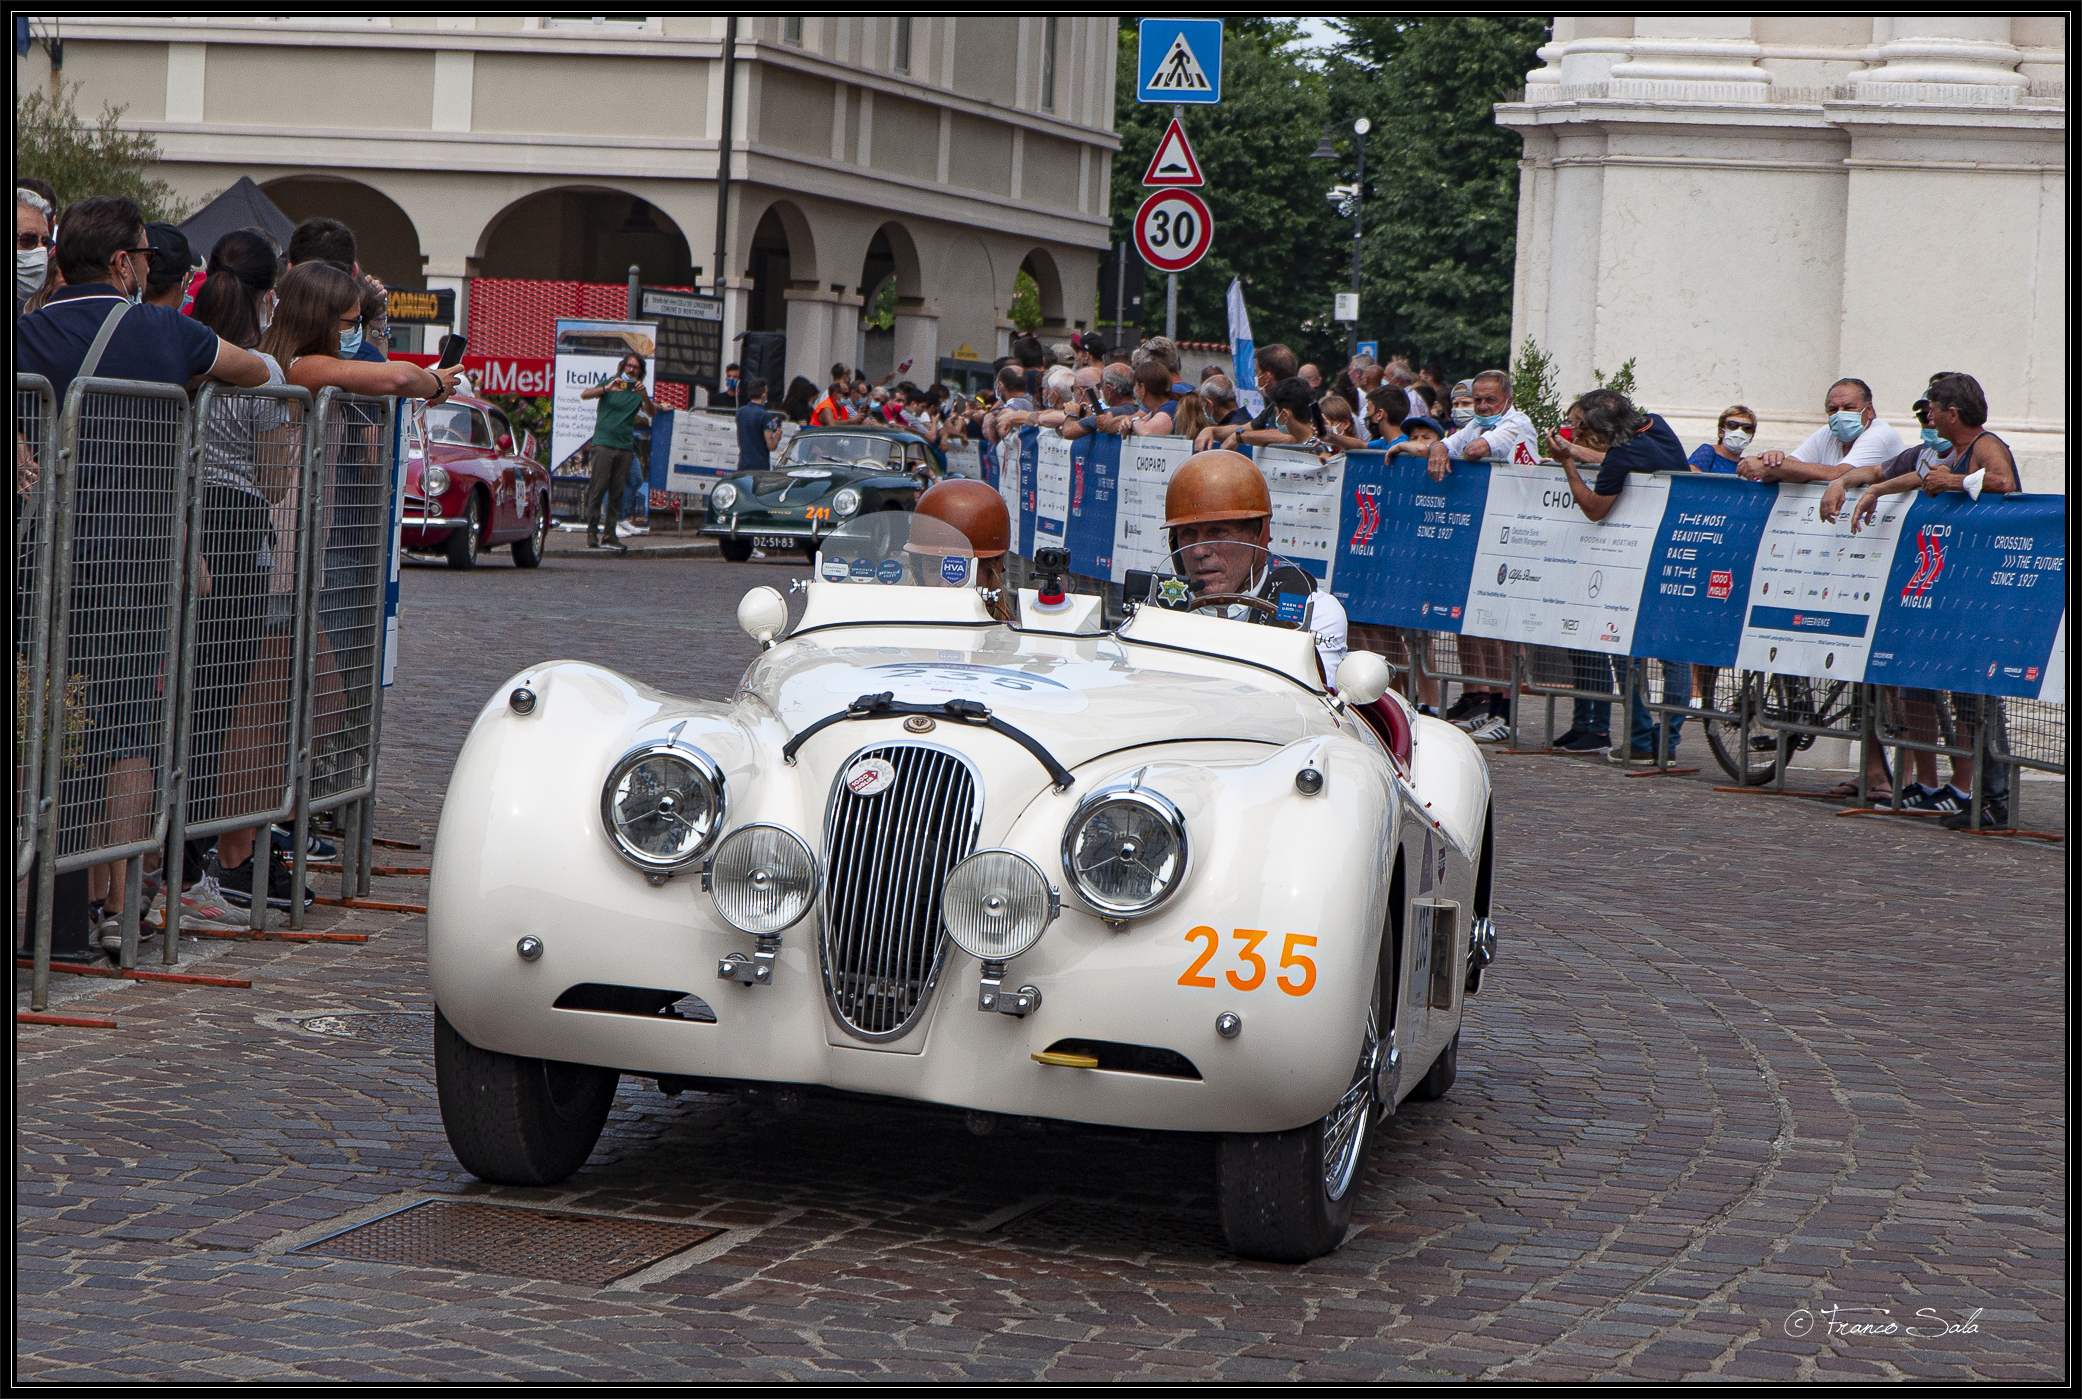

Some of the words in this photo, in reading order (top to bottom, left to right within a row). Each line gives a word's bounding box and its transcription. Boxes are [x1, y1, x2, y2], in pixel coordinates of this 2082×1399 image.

[1150, 209, 1195, 250] 30
[1136, 456, 1166, 473] CHOPARD
[1358, 484, 1382, 496] 1000
[1415, 495, 1447, 509] CROSSING
[805, 505, 831, 521] 241
[1434, 512, 1446, 524] THE
[1447, 513, 1472, 526] FUTURE
[1678, 512, 1702, 525] THE
[1701, 515, 1727, 527] MOST
[1416, 525, 1435, 539] SINCE
[1437, 528, 1454, 540] 1927
[1671, 530, 1724, 545] BEAUTIFUL
[1921, 524, 1952, 538] 1000
[1993, 535, 2034, 551] CROSSING
[1350, 544, 1375, 557] MIGLIA
[1666, 547, 1698, 561] RACE
[944, 563, 965, 572] HVA
[2016, 555, 2033, 569] THE
[2033, 555, 2065, 571] FUTURE
[1508, 568, 1522, 585] Alfa
[1522, 568, 1543, 582] Romeo
[1662, 565, 1673, 577] IN
[1674, 565, 1698, 579] THE
[1712, 573, 1729, 585] 1000
[1990, 571, 2015, 586] SINCE
[2016, 573, 2039, 588] 1927
[1659, 583, 1697, 597] WORLD
[1708, 586, 1728, 597] MIGLIA
[1900, 595, 1933, 609] MIGLIA
[881, 668, 1035, 691] 235
[851, 774, 869, 787] 1000
[854, 776, 874, 791] MIGLIA
[1177, 925, 1318, 997] 235
